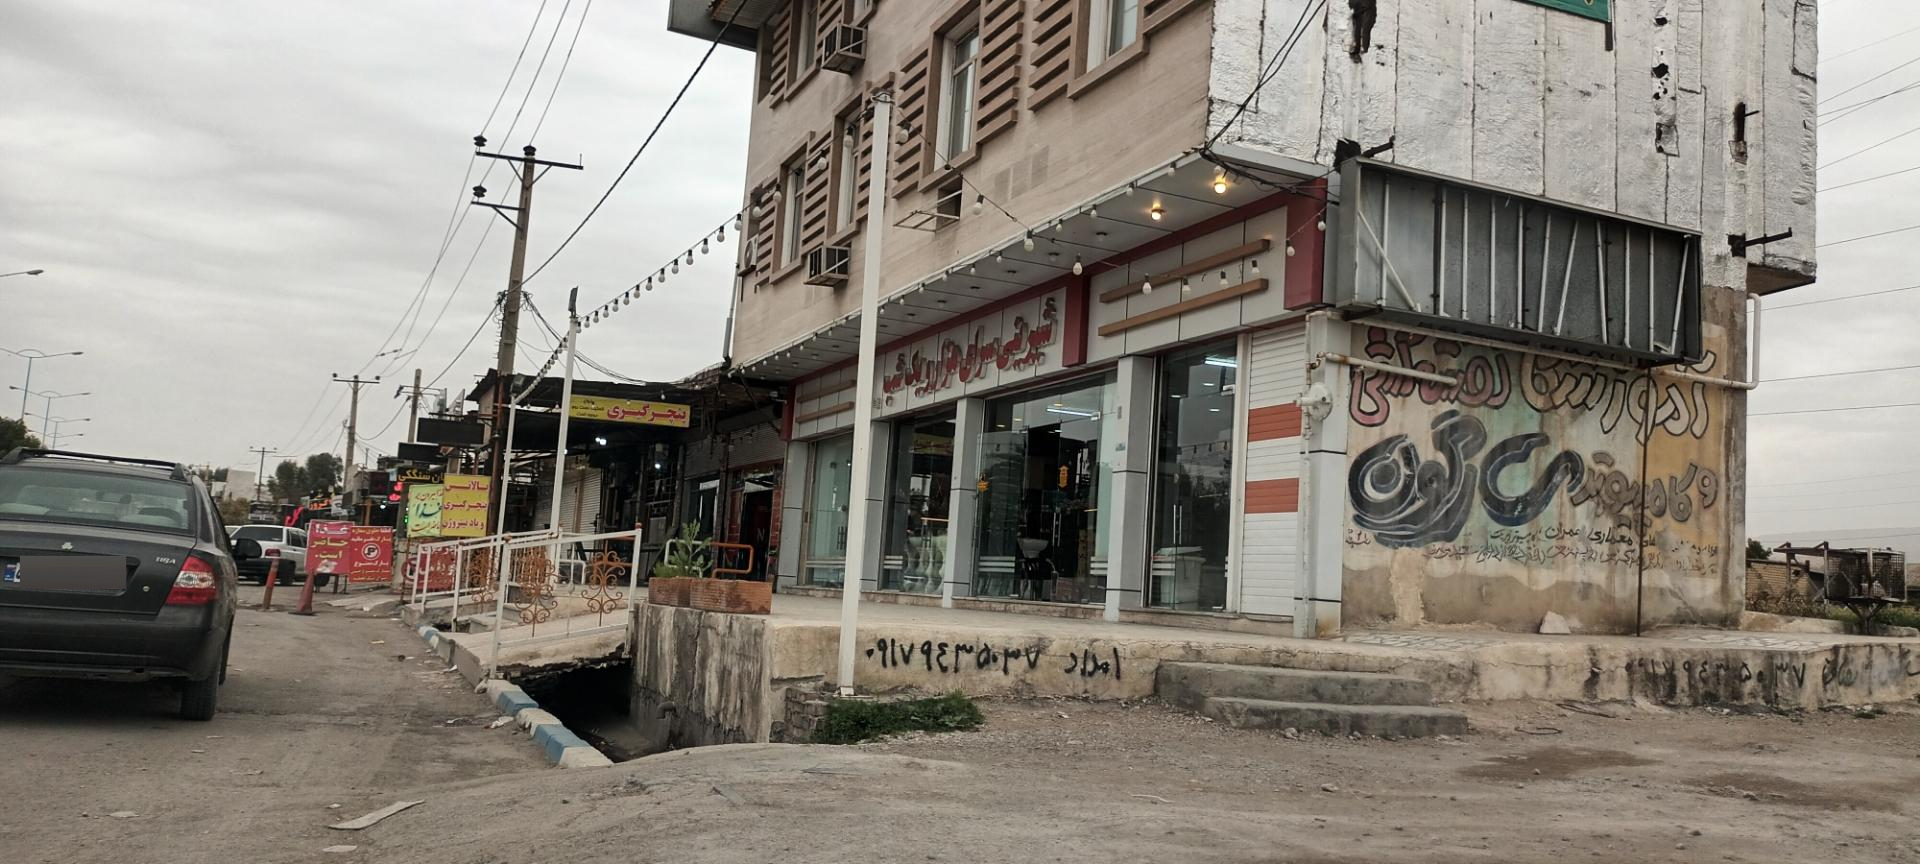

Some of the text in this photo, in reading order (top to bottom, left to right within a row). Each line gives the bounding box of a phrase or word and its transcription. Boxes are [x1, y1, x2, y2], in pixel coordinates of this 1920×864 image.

[997, 297, 1058, 371] شیرینی
[957, 325, 1000, 383] سرای
[883, 352, 907, 407] شب
[432, 471, 444, 484] ان
[445, 480, 489, 491] بالانس
[416, 503, 443, 518] غذا
[315, 523, 349, 535] غذا
[1545, 521, 1580, 540] عمران
[1588, 526, 1633, 546] معماری
[310, 536, 349, 548] حاضر
[1064, 647, 1122, 681] امداد
